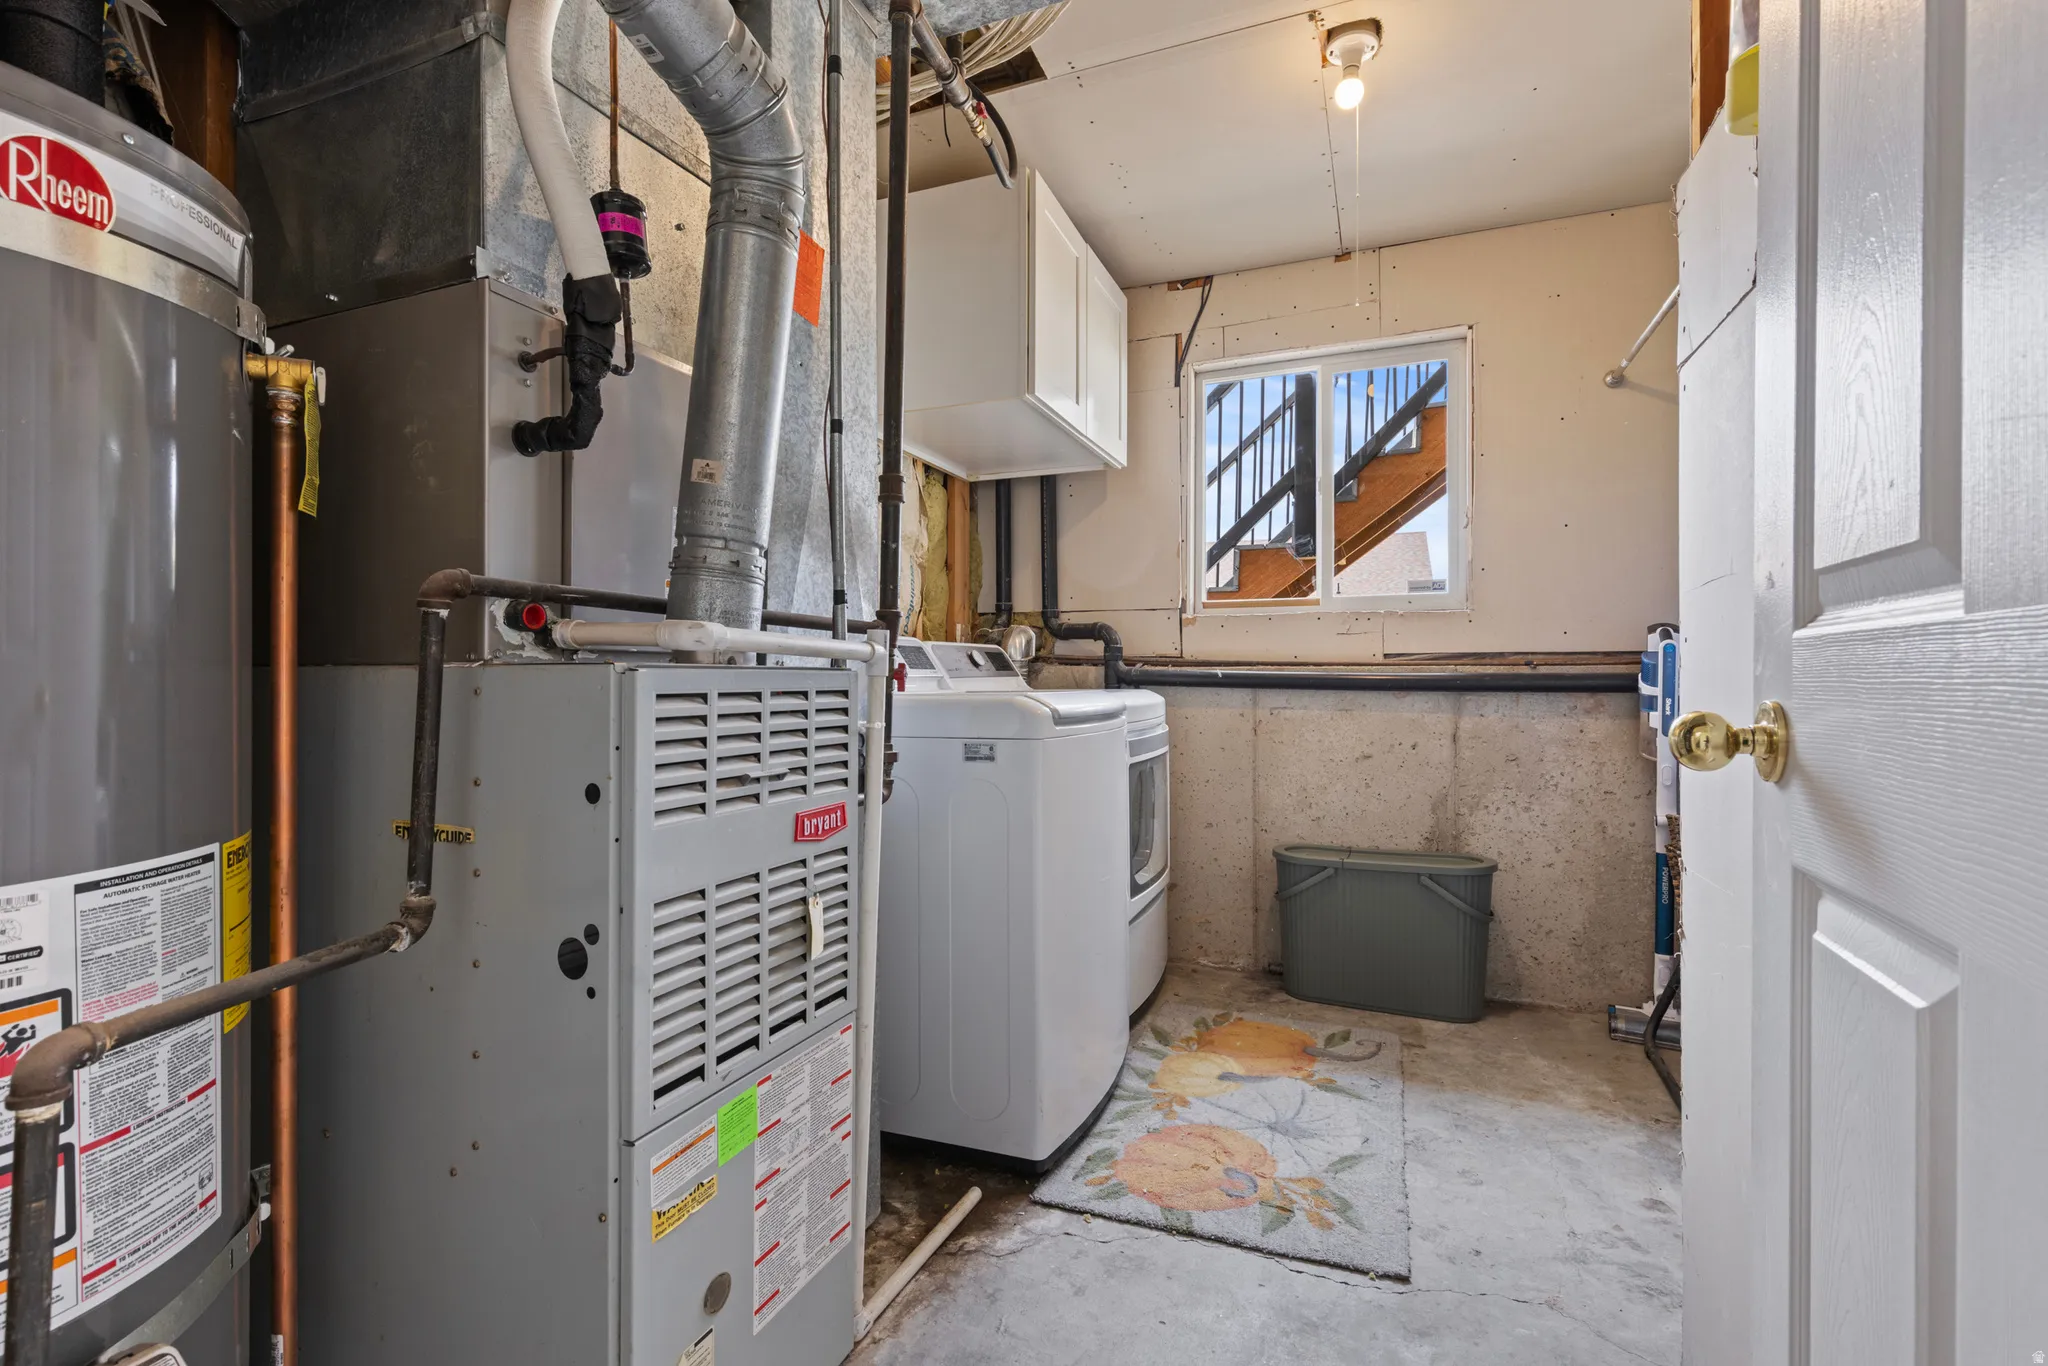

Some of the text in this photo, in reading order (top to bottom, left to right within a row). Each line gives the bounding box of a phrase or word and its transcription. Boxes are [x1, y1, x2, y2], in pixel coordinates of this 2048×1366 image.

[8, 138, 109, 225] Rheem
[150, 183, 238, 250] PROFESSIONAL
[395, 825, 472, 844] ENYGUIDE
[804, 809, 841, 836] bryant
[100, 858, 203, 888] INSTALLATION AND OPERATION DETAILS
[103, 869, 201, 899] AUTOMATIC STORAGE WATER HEATER
[1661, 866, 1669, 905] POWERPRO
[7, 949, 39, 961] CERTIFIED
